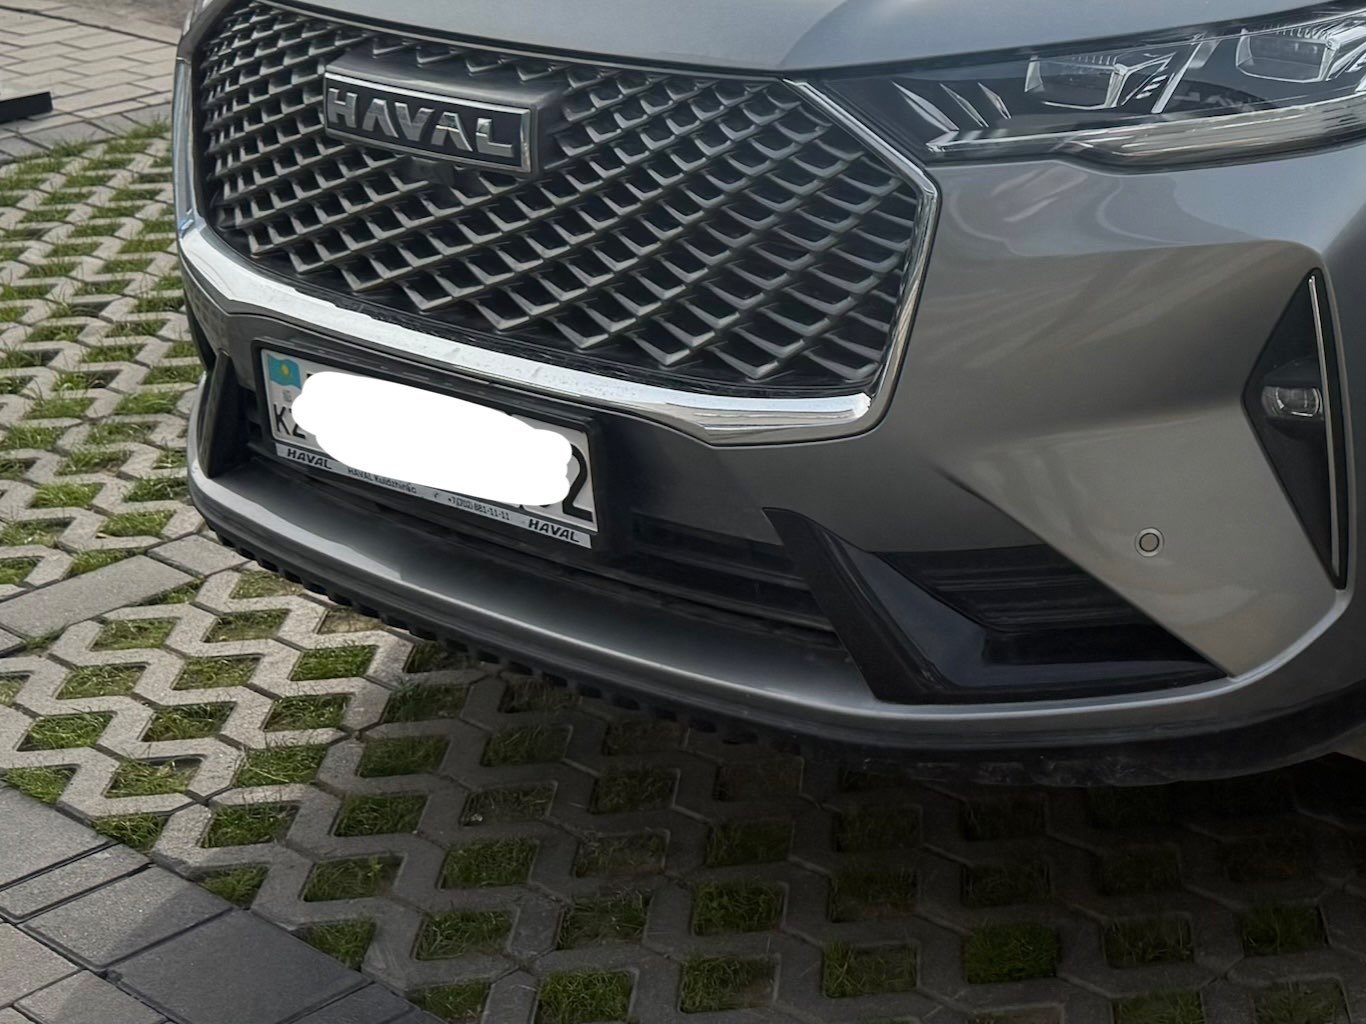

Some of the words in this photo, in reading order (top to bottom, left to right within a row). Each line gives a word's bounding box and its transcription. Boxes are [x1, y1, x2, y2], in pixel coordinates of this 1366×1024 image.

[328, 87, 514, 158] HAVAL
[287, 448, 332, 470] HAVAL
[528, 519, 579, 543] HAVAL
